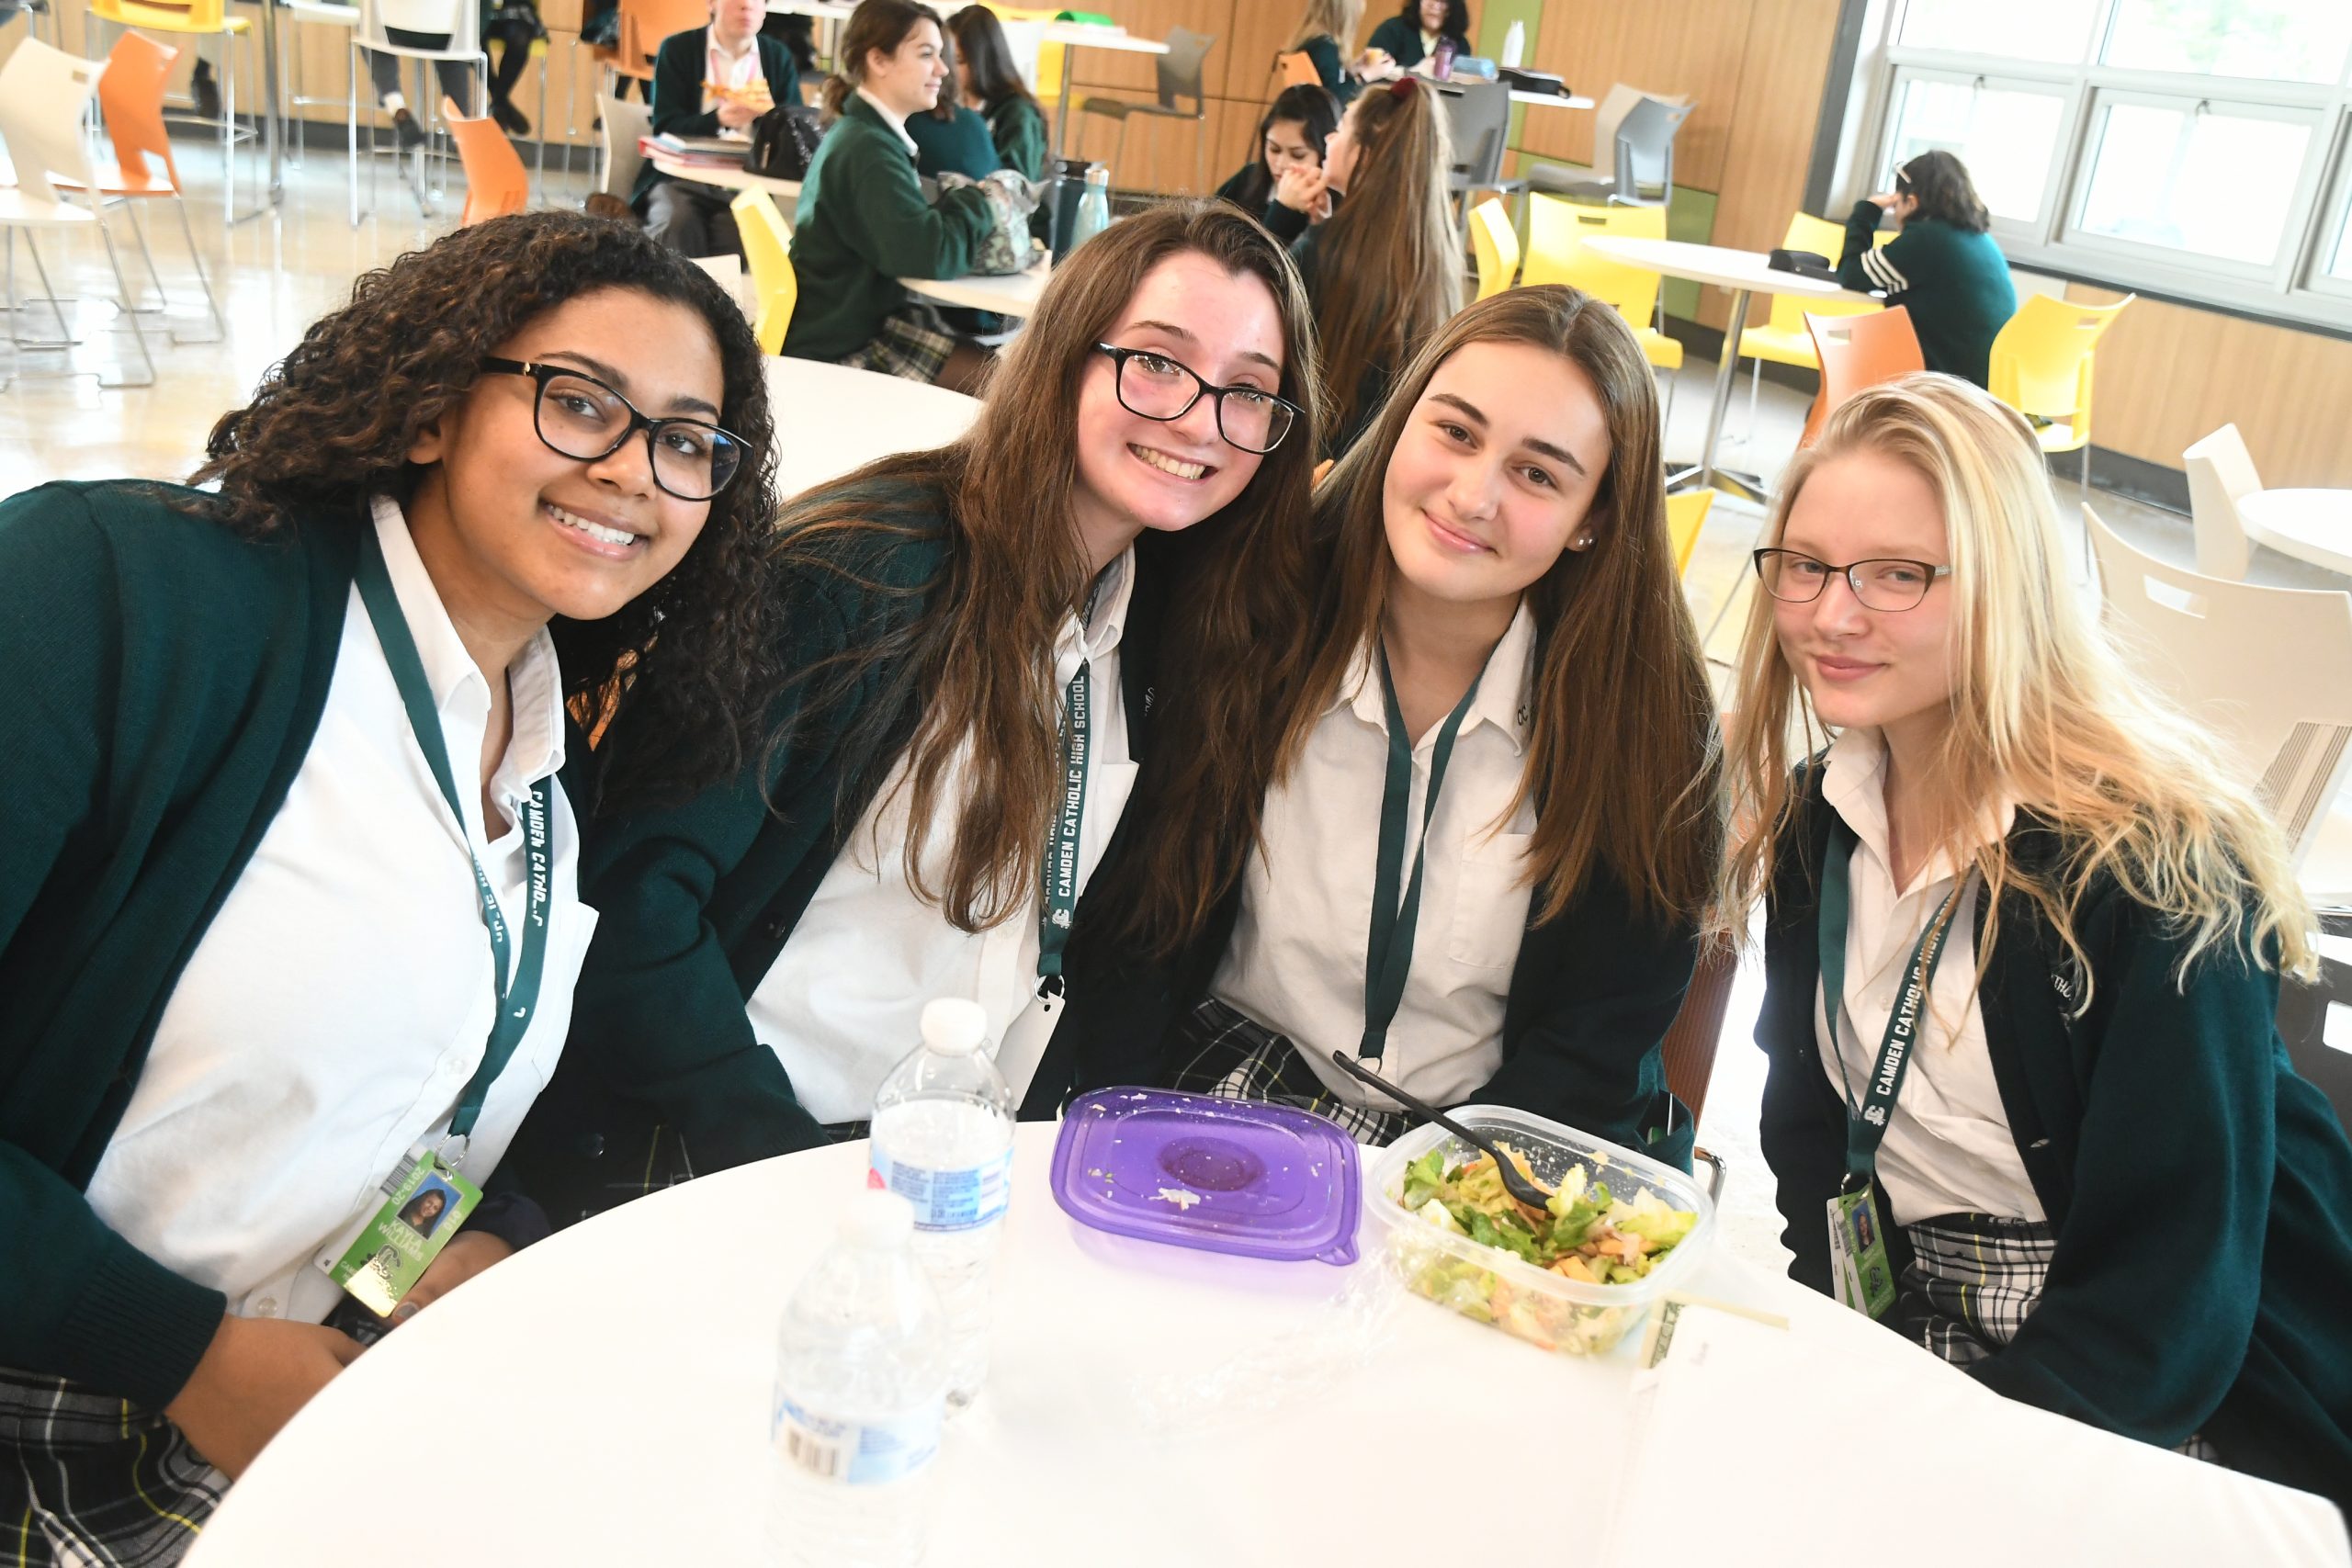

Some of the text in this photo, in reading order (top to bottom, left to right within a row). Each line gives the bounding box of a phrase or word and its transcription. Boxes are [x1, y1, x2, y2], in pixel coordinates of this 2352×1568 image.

[1058, 675, 1086, 897] CAMDEN CATHOLIC HIGH SCHOOL
[1875, 1039, 1905, 1096] CAMDEN
[391, 1165, 425, 1206] 2019-20
[378, 1222, 424, 1262] WILLIAMS
[389, 1218, 424, 1250] KAYLA
